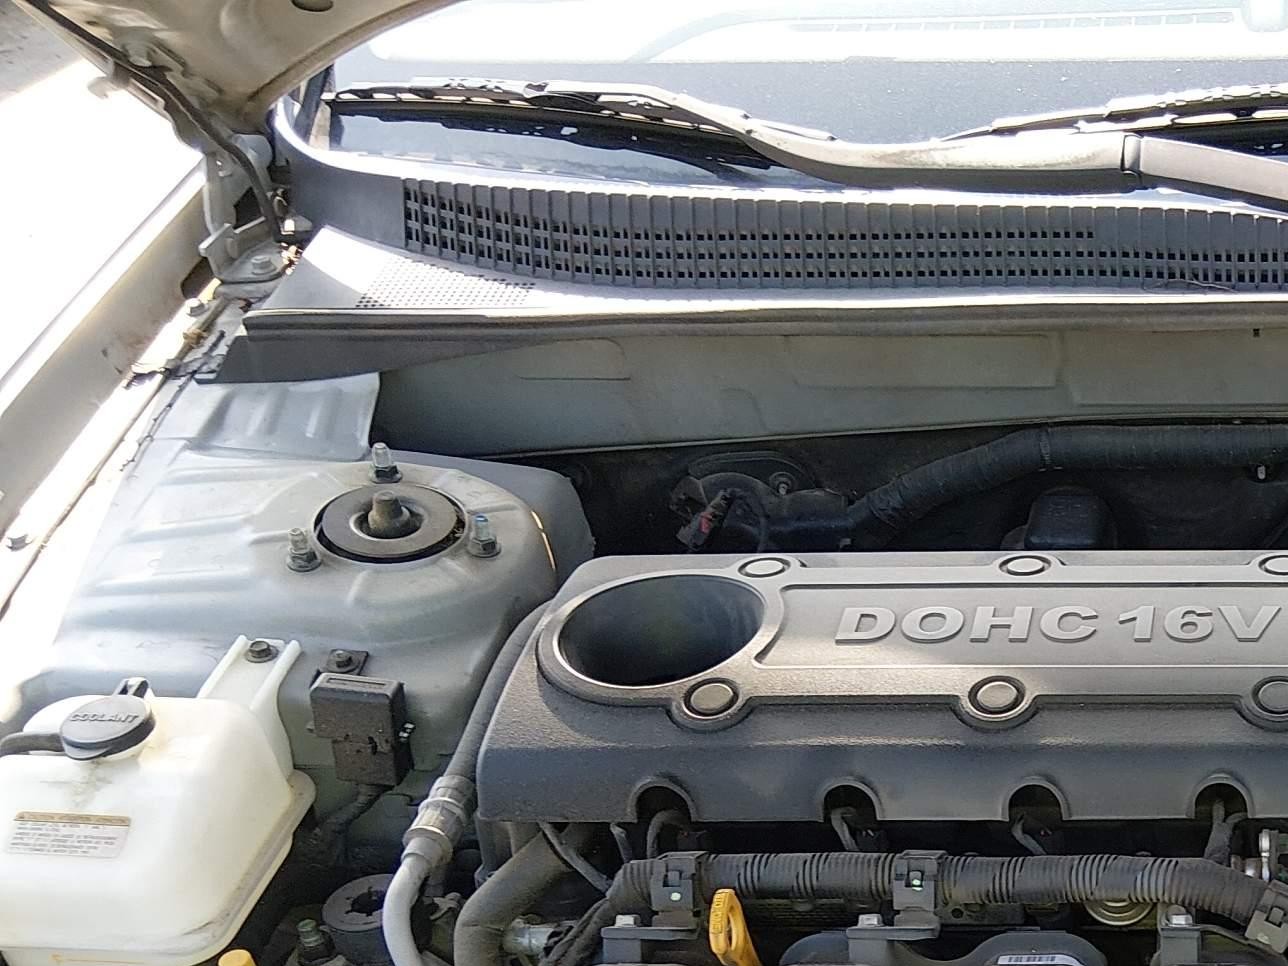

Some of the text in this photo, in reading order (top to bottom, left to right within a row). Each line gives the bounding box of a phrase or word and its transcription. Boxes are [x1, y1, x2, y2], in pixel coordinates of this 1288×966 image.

[835, 605, 1281, 643] DOHC 16V
[71, 713, 140, 723] COOLANT
